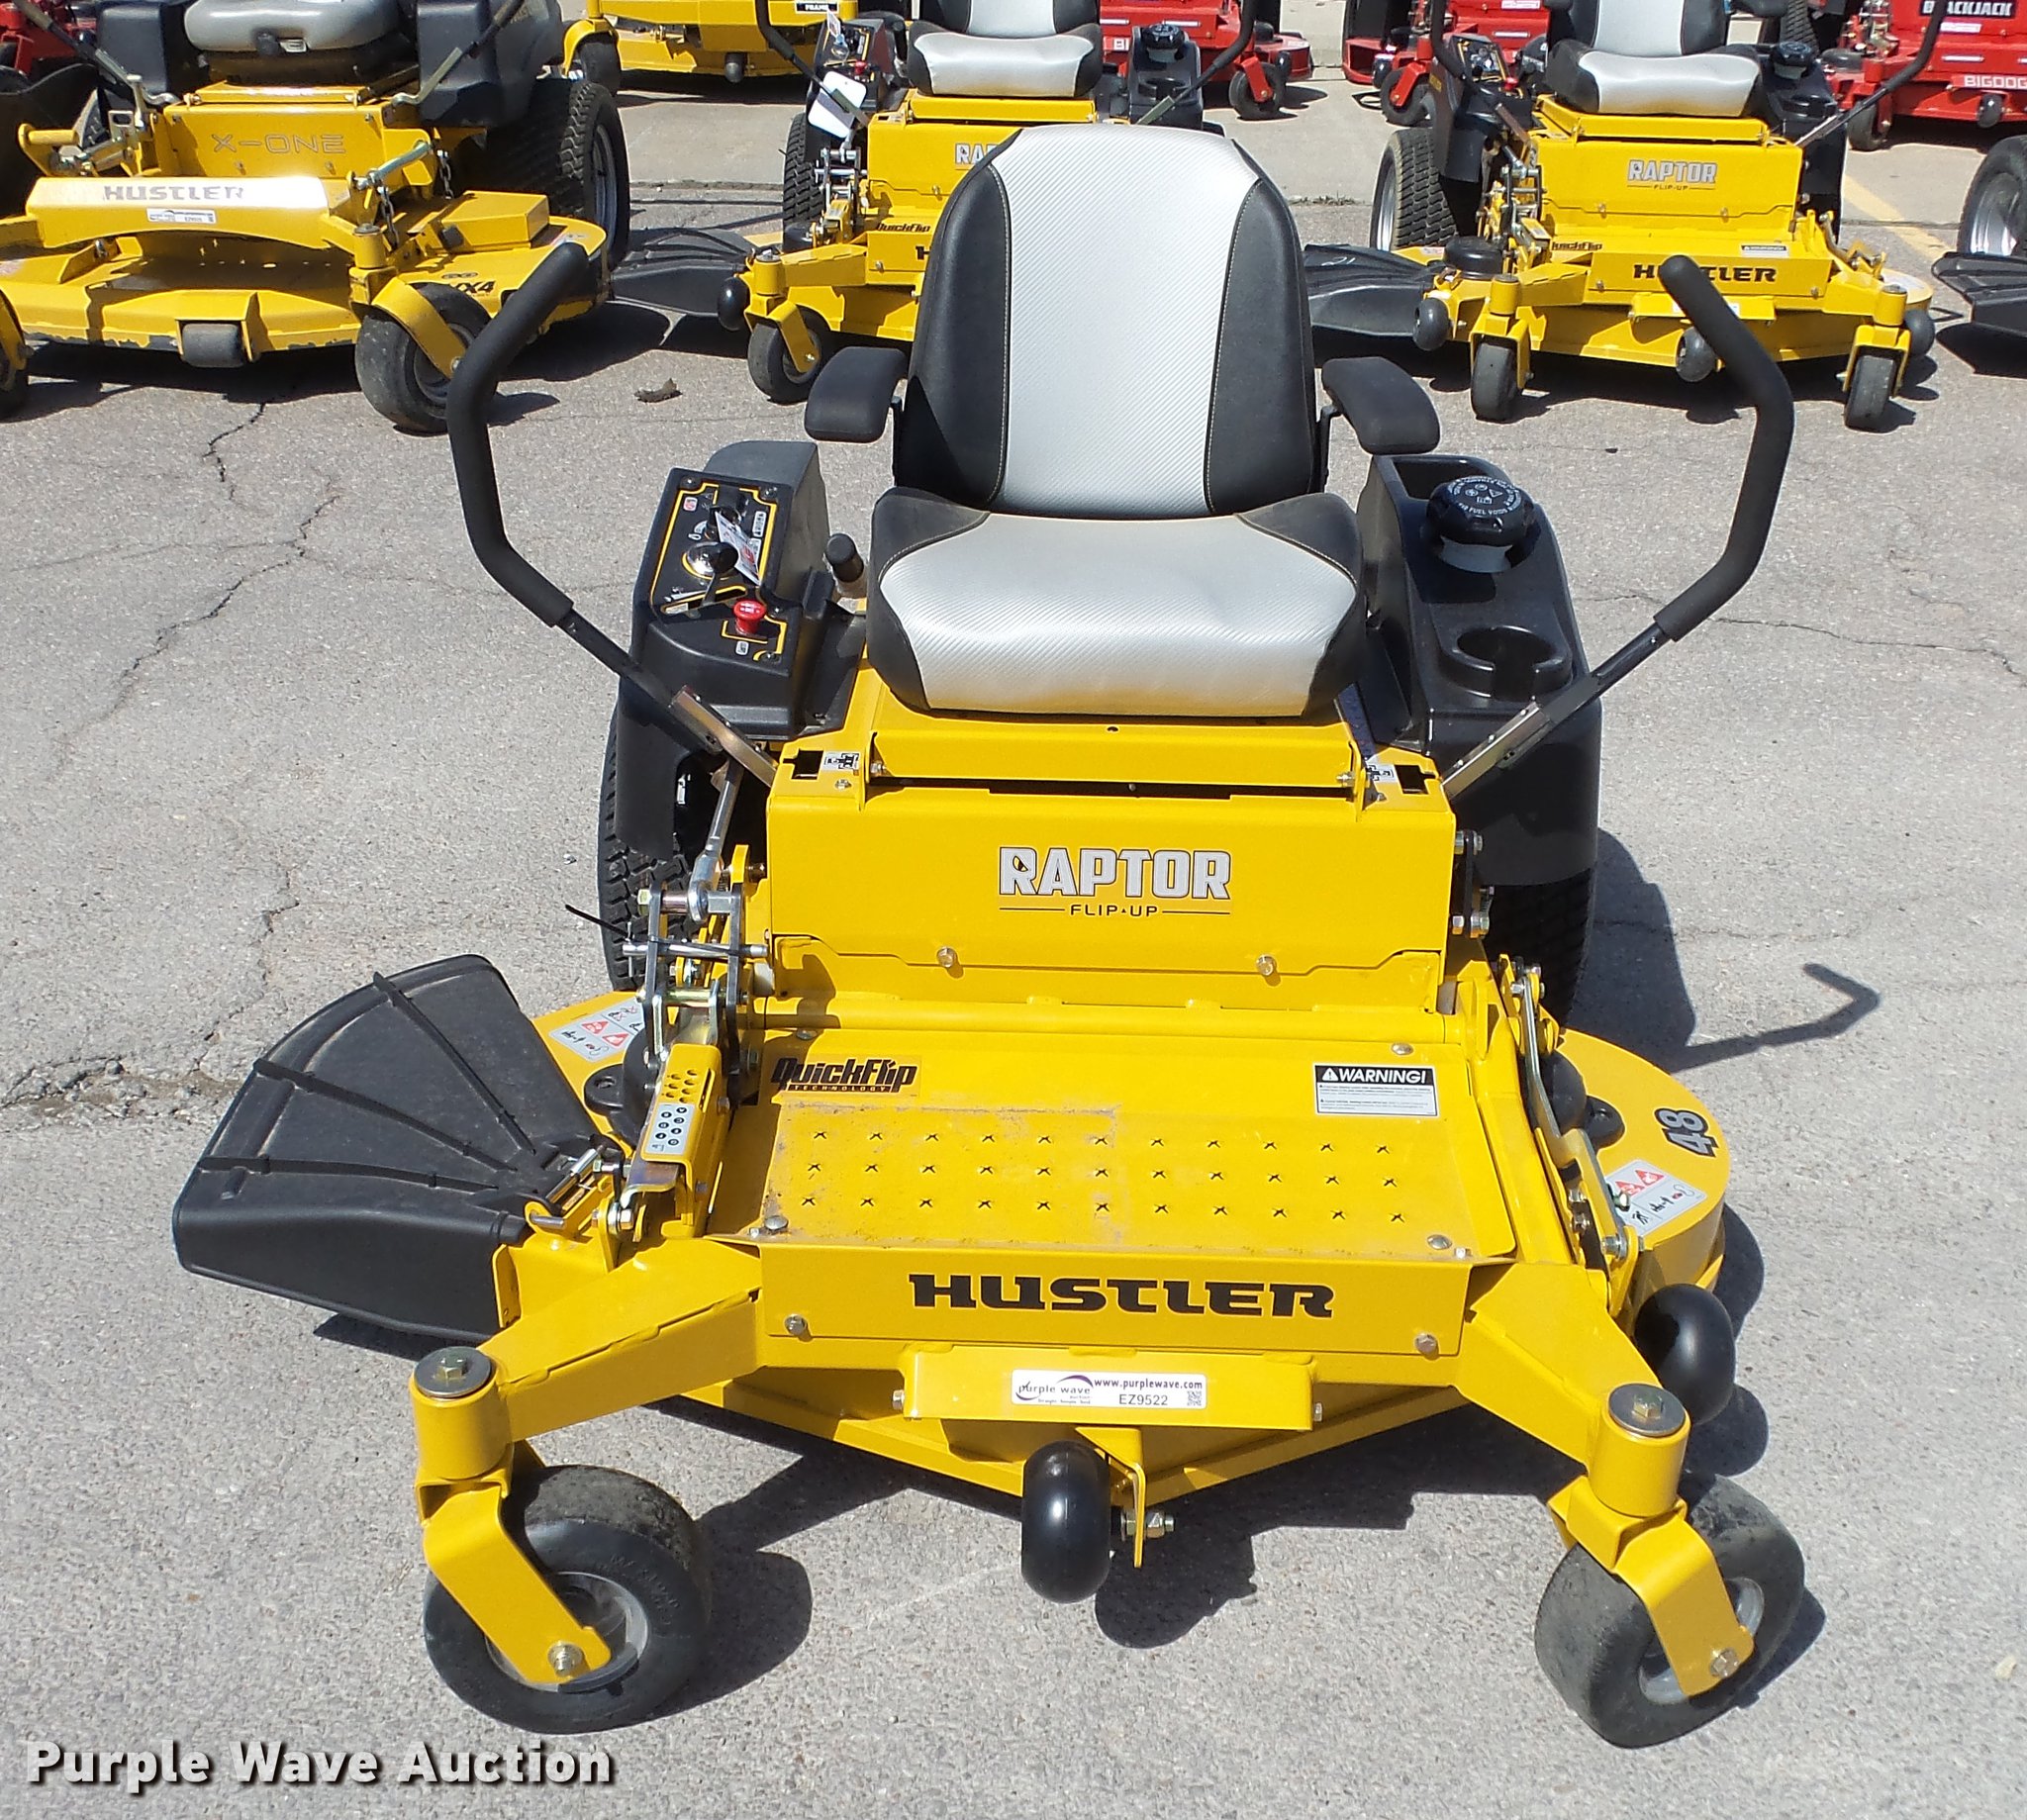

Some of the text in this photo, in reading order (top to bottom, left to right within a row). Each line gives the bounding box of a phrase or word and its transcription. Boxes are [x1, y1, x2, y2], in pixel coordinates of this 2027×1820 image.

[212, 134, 346, 153] X-ONE
[1628, 159, 1717, 183] RAPTOR
[104, 185, 244, 201] HUSTLER
[999, 846, 1231, 900] RAPTOR
[771, 1057, 918, 1093] QuickFlip
[1338, 1068, 1426, 1084] WARNING!
[1654, 1107, 1719, 1158] 48
[909, 1274, 1336, 1318] HUSTLER
[1017, 1382, 1056, 1397] purple
[1094, 1378, 1204, 1390] www.purplewave.com
[1118, 1393, 1169, 1406] EZ9522
